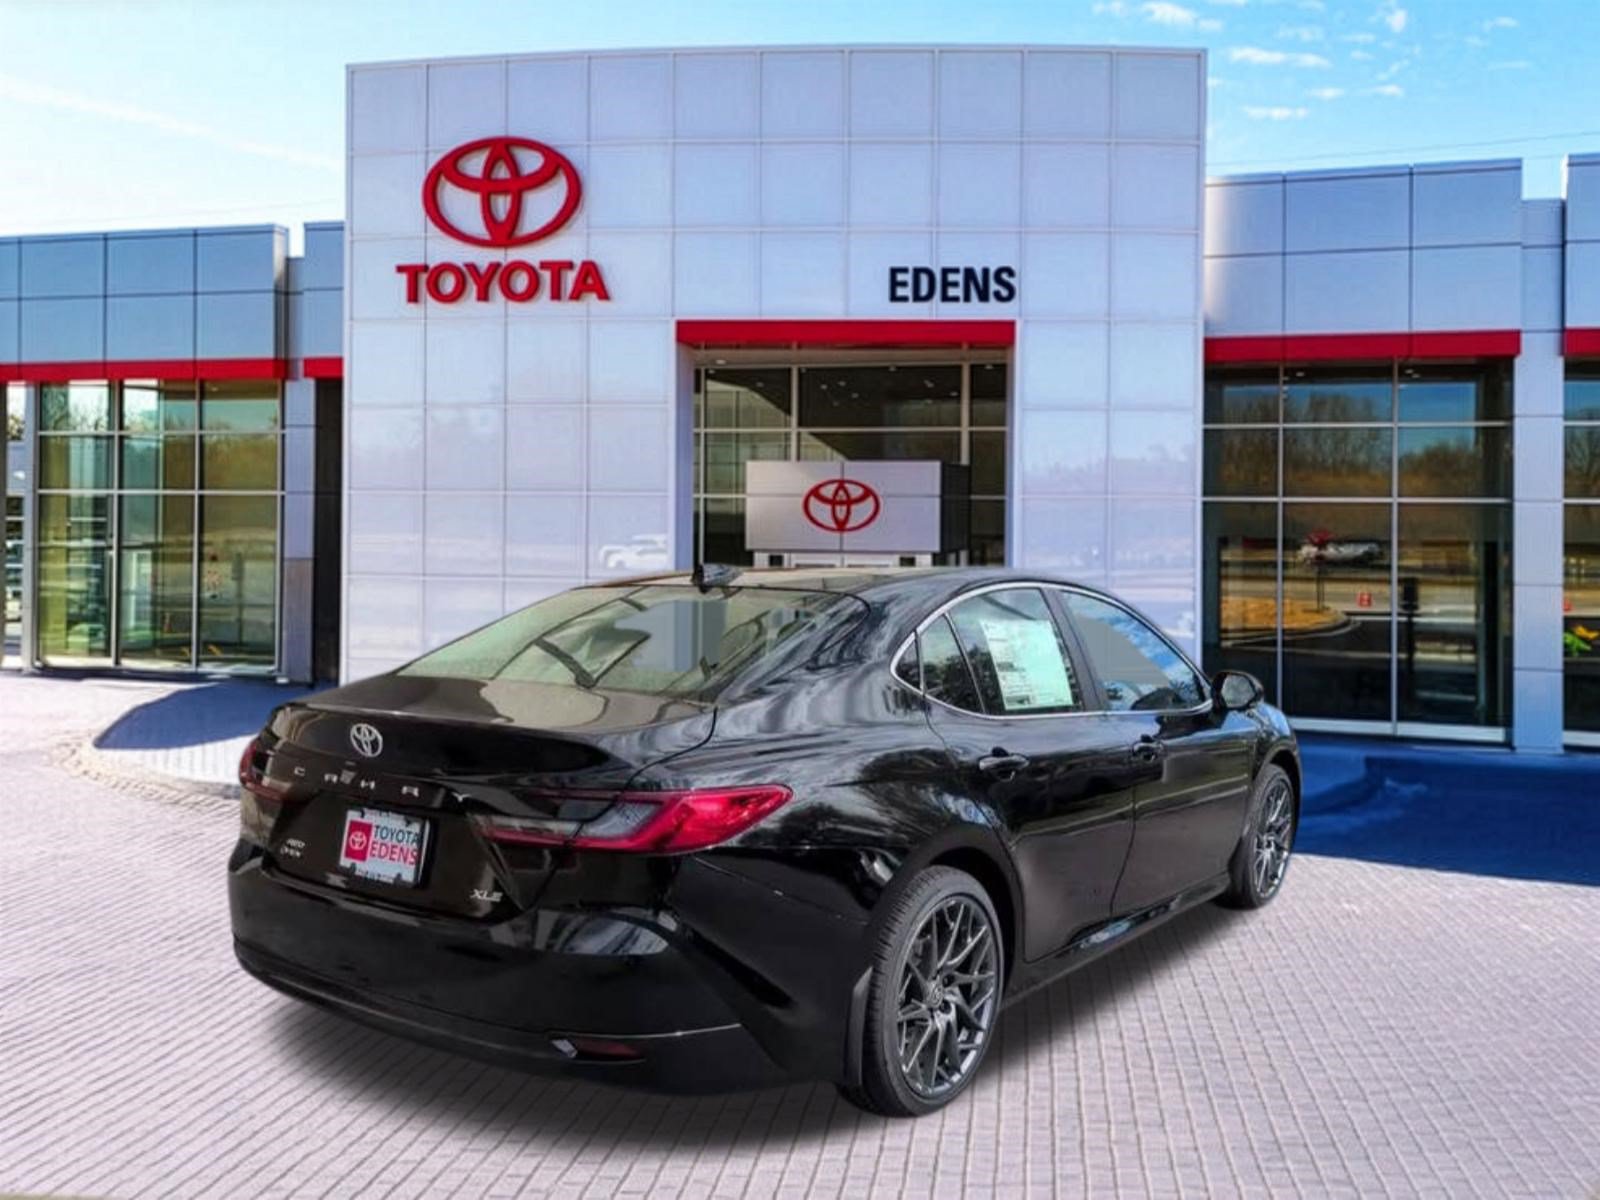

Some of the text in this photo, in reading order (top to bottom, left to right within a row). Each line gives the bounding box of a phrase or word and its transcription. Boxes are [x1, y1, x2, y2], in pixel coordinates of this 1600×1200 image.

[396, 260, 610, 304] TOYOTA
[889, 266, 1017, 303] EDENS
[374, 824, 421, 848] TOYOTA
[368, 841, 420, 866] EDENS
